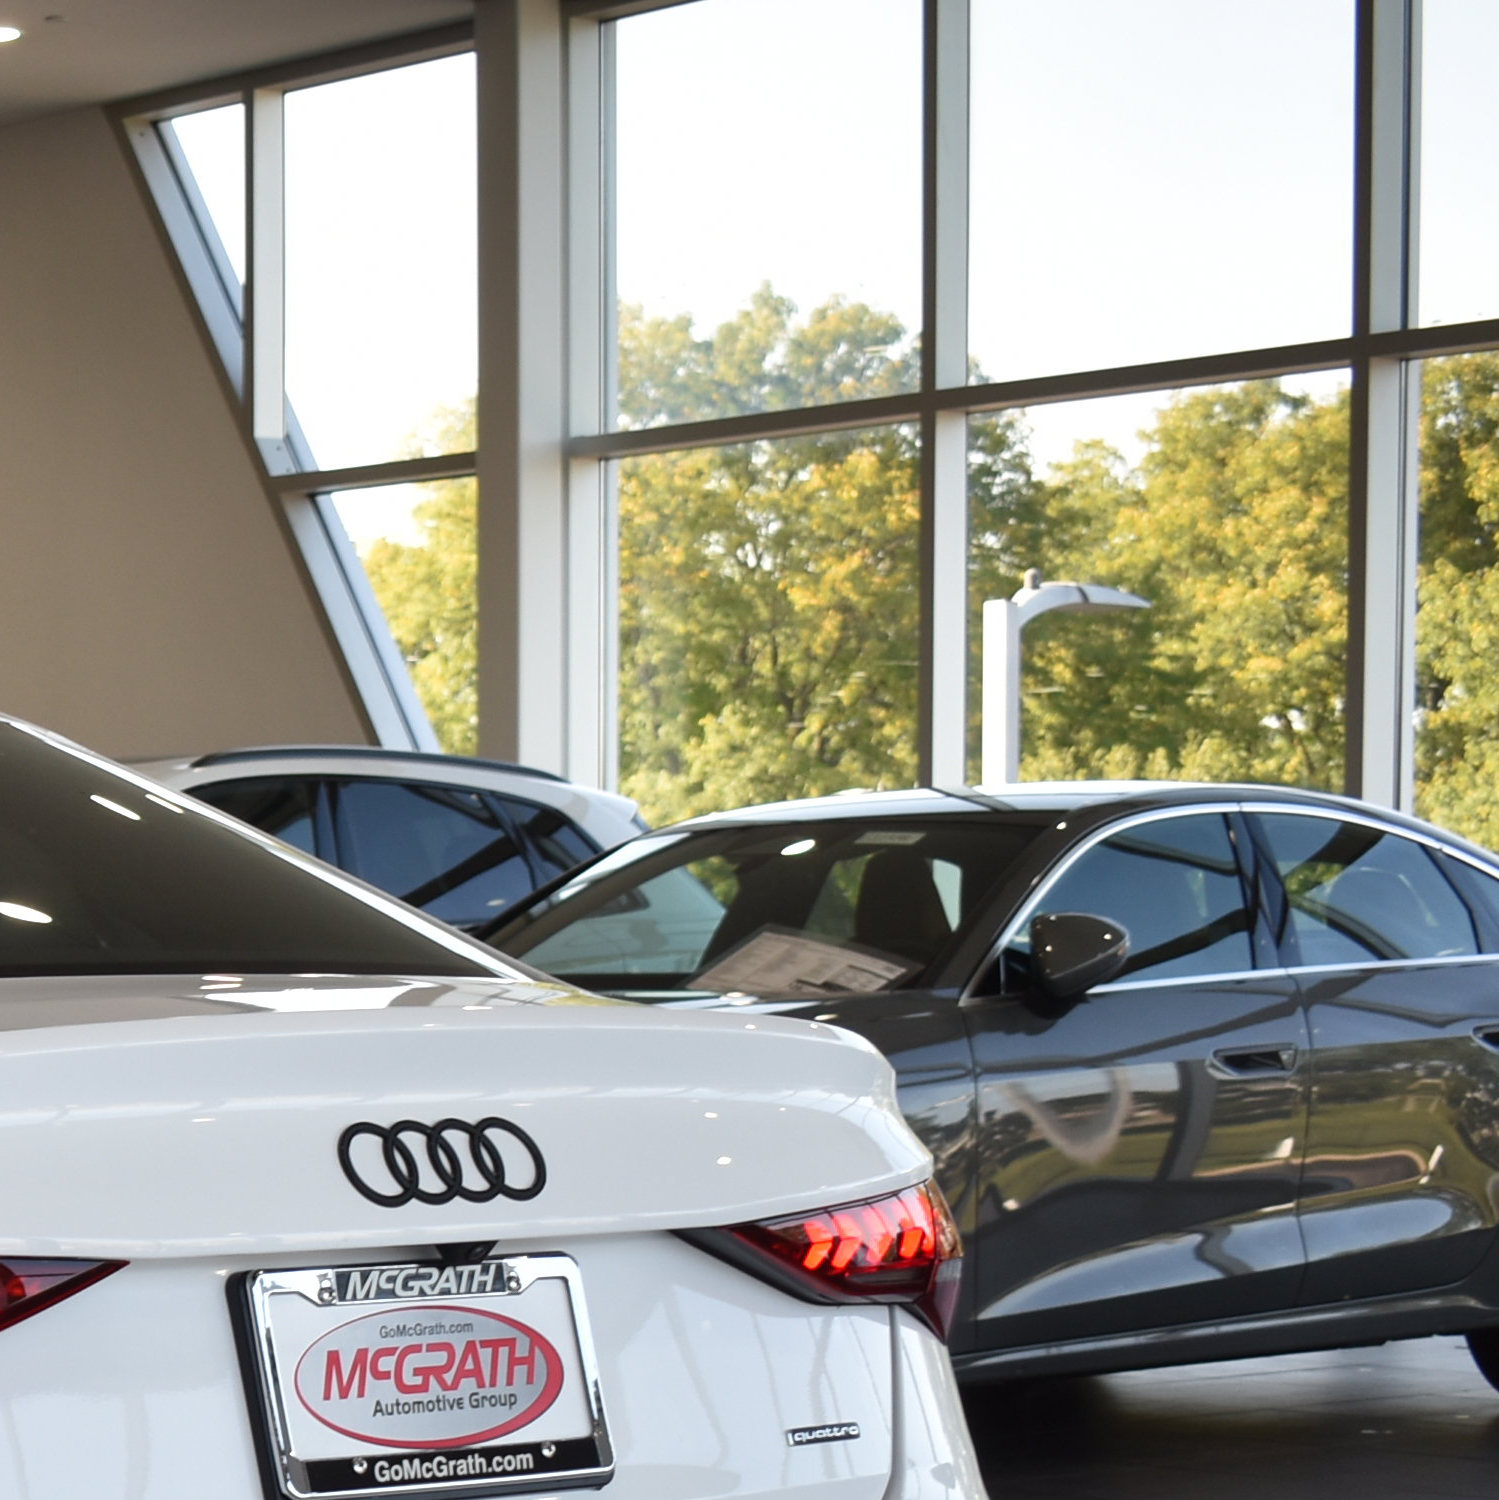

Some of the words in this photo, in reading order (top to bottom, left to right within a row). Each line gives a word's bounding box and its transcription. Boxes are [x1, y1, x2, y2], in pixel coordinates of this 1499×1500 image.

[379, 1321, 474, 1339] GoMcGrath.com
[372, 1394, 464, 1417] Automotive
[469, 1391, 517, 1410] Group
[793, 1425, 859, 1442] quattro
[374, 1452, 534, 1483] GoMcGrath.com
